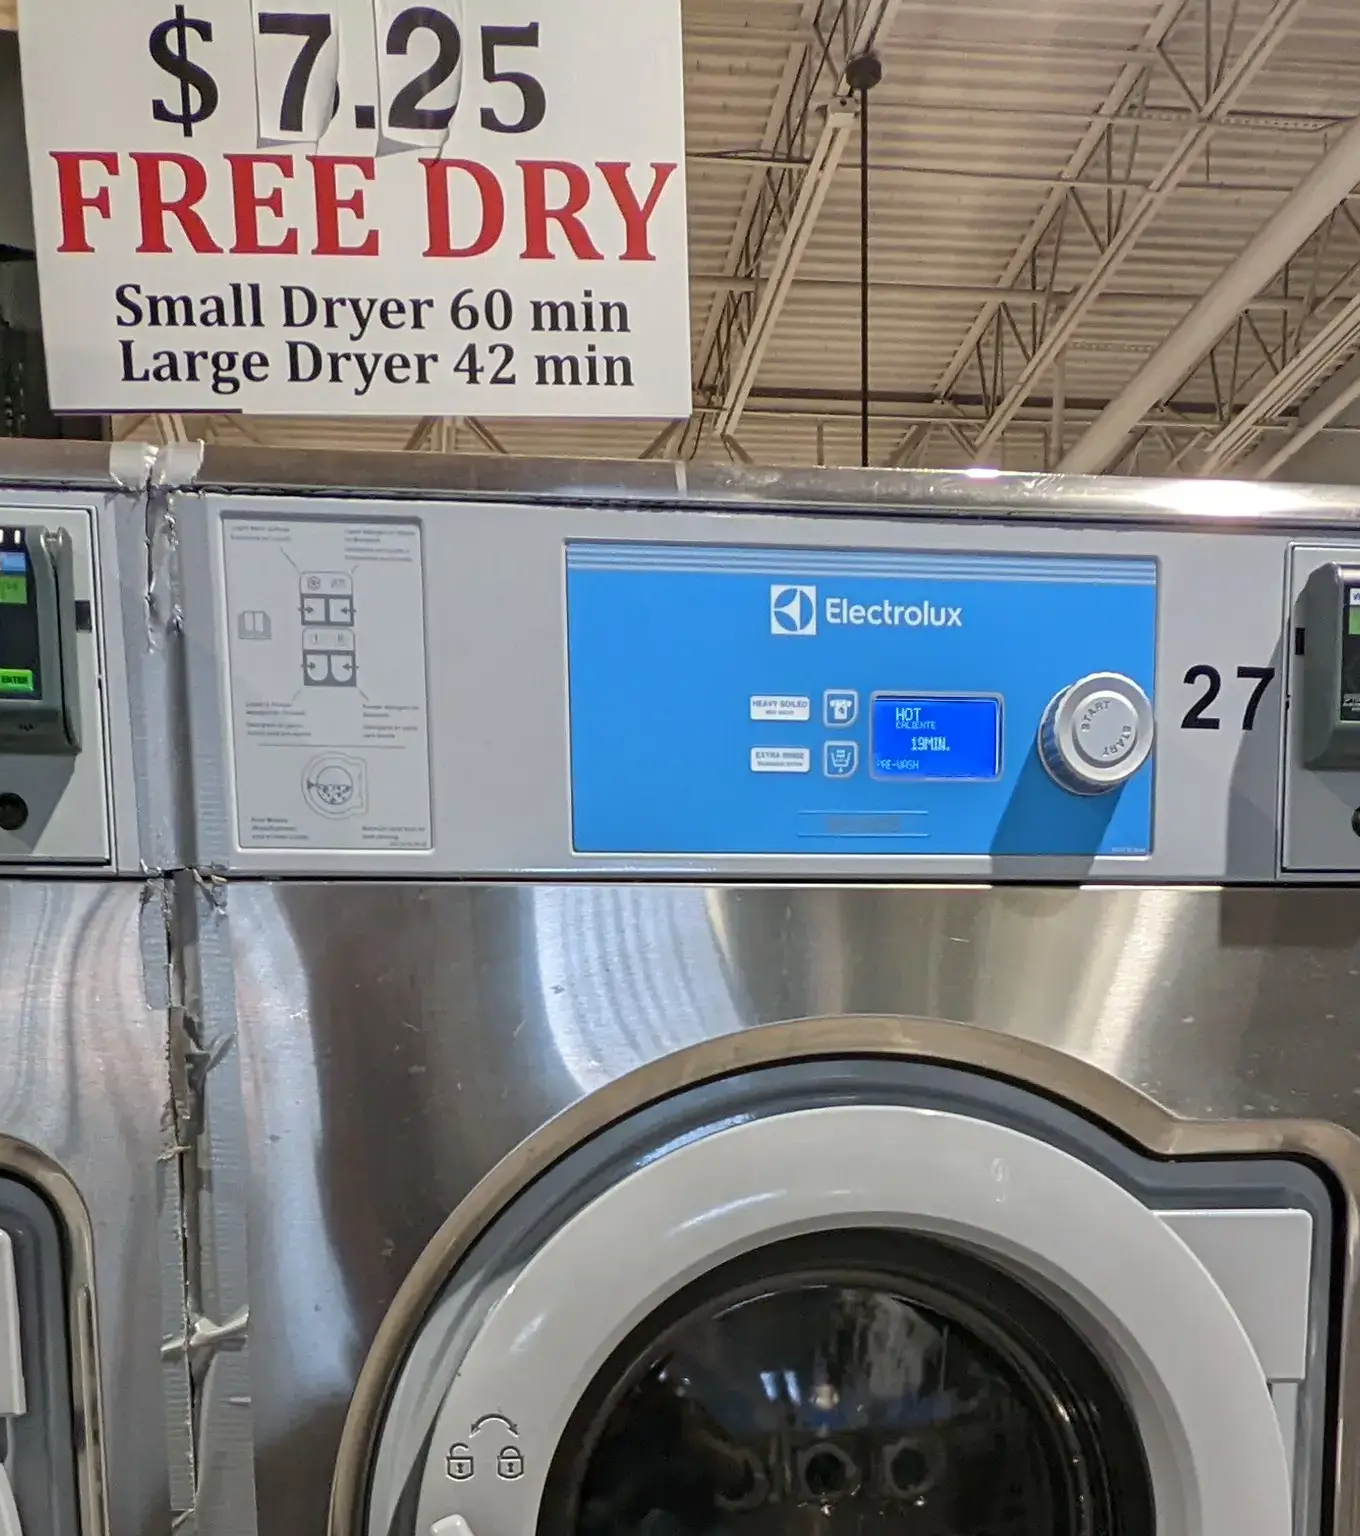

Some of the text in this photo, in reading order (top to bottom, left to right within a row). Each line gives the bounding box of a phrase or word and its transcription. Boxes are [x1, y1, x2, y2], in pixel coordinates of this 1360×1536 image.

[49, 151, 678, 261] FREE DRY
[115, 282, 632, 341] Small Dryer 60 min
[120, 339, 635, 396] Large Dryer 42 min
[826, 597, 963, 628] Electrolux
[895, 707, 922, 721] HOT
[1081, 700, 1111, 731] START
[1180, 664, 1276, 731] 27
[1101, 725, 1132, 756] START
